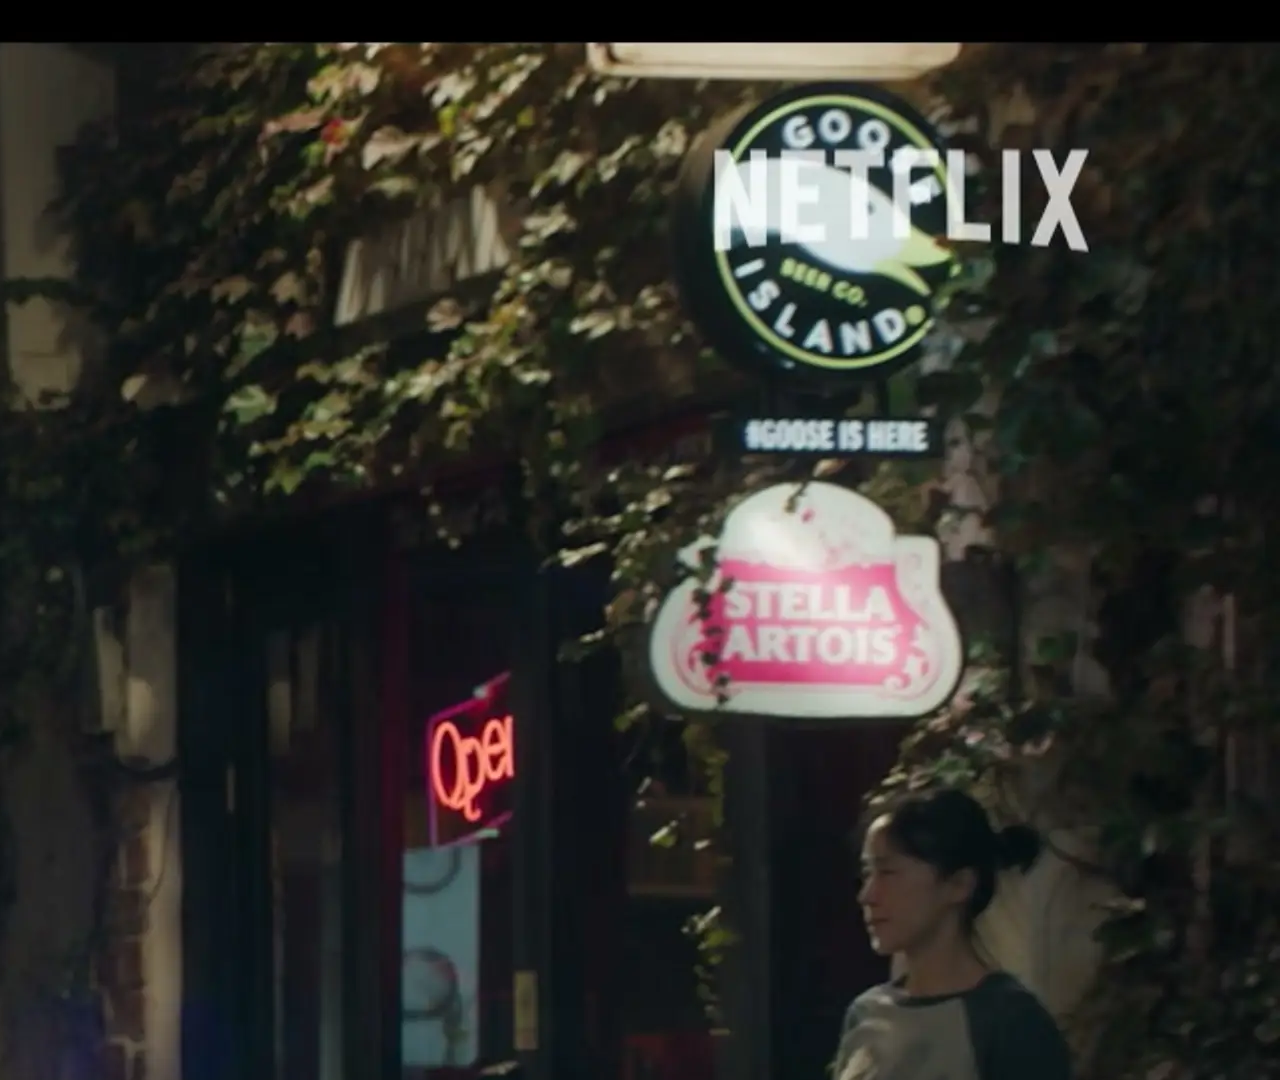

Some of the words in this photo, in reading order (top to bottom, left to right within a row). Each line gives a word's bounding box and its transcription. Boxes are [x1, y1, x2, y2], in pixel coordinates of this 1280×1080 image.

[734, 257, 907, 355] ISLAND
[839, 420, 864, 450] IS
[867, 420, 929, 452] HERE
[724, 580, 896, 622] STELLA
[721, 624, 899, 665] ARTOIS
